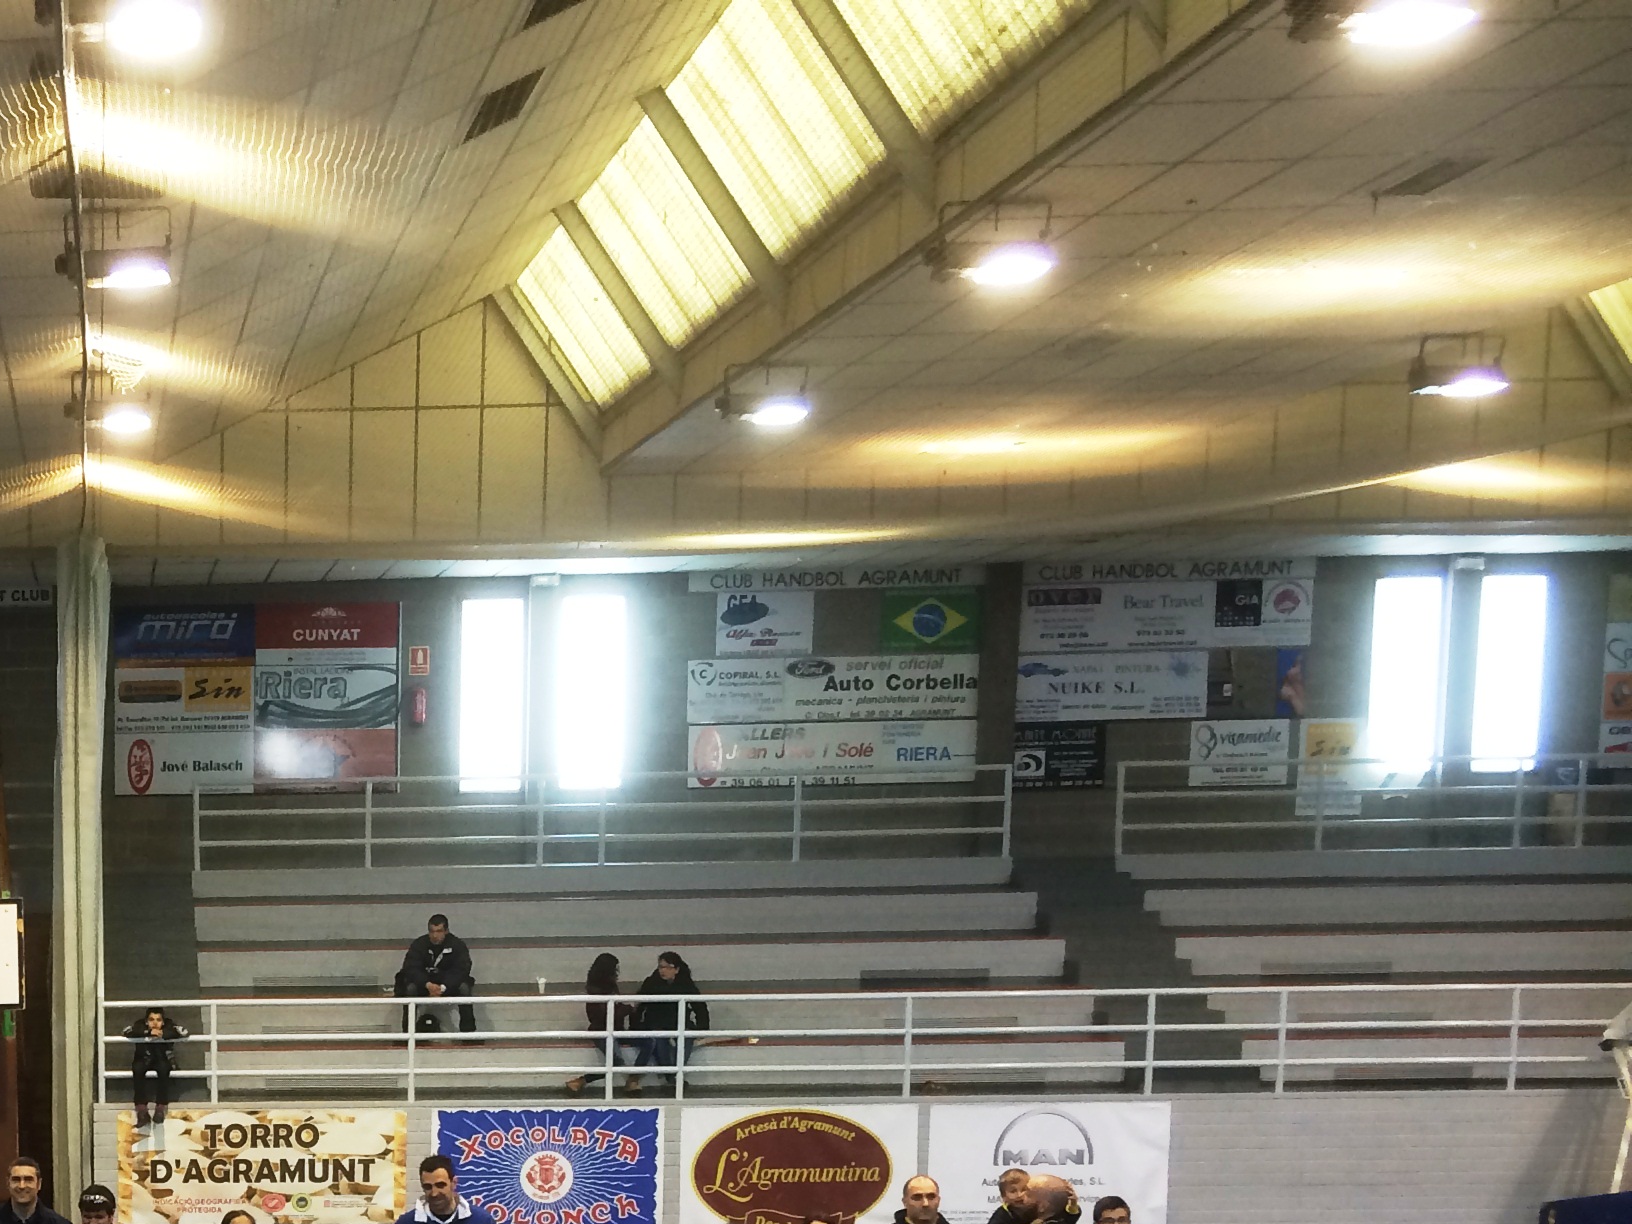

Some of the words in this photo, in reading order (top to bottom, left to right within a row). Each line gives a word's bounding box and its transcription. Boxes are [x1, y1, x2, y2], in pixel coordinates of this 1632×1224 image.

[710, 573, 753, 589] CLUB
[762, 571, 845, 588] HANDBOL
[858, 568, 962, 586] AGRAMUNT
[1039, 564, 1082, 580] CLUB
[1092, 562, 1178, 579] HANDBOL
[1188, 559, 1293, 577] AGRAMUNT
[11, 589, 50, 602] CLUB
[293, 629, 361, 642] CUNYAT
[846, 659, 891, 671] servei
[898, 657, 945, 670] oficial
[259, 671, 347, 700] Riera
[823, 675, 875, 692] Auto
[886, 673, 978, 692] Corbella
[835, 742, 874, 758] Solé
[896, 746, 952, 761] RIERA
[160, 760, 188, 773] Jové
[192, 760, 243, 772] Balasch
[203, 1115, 320, 1149] TORRÓ
[735, 1117, 778, 1142] Artesà
[779, 1115, 857, 1142] d'Agramunt
[457, 1125, 640, 1164] XOCOLATA
[1002, 1149, 1085, 1166] MAN
[149, 1157, 376, 1184] D'AGRAMUNT
[703, 1147, 882, 1203] L'Agramuntina
